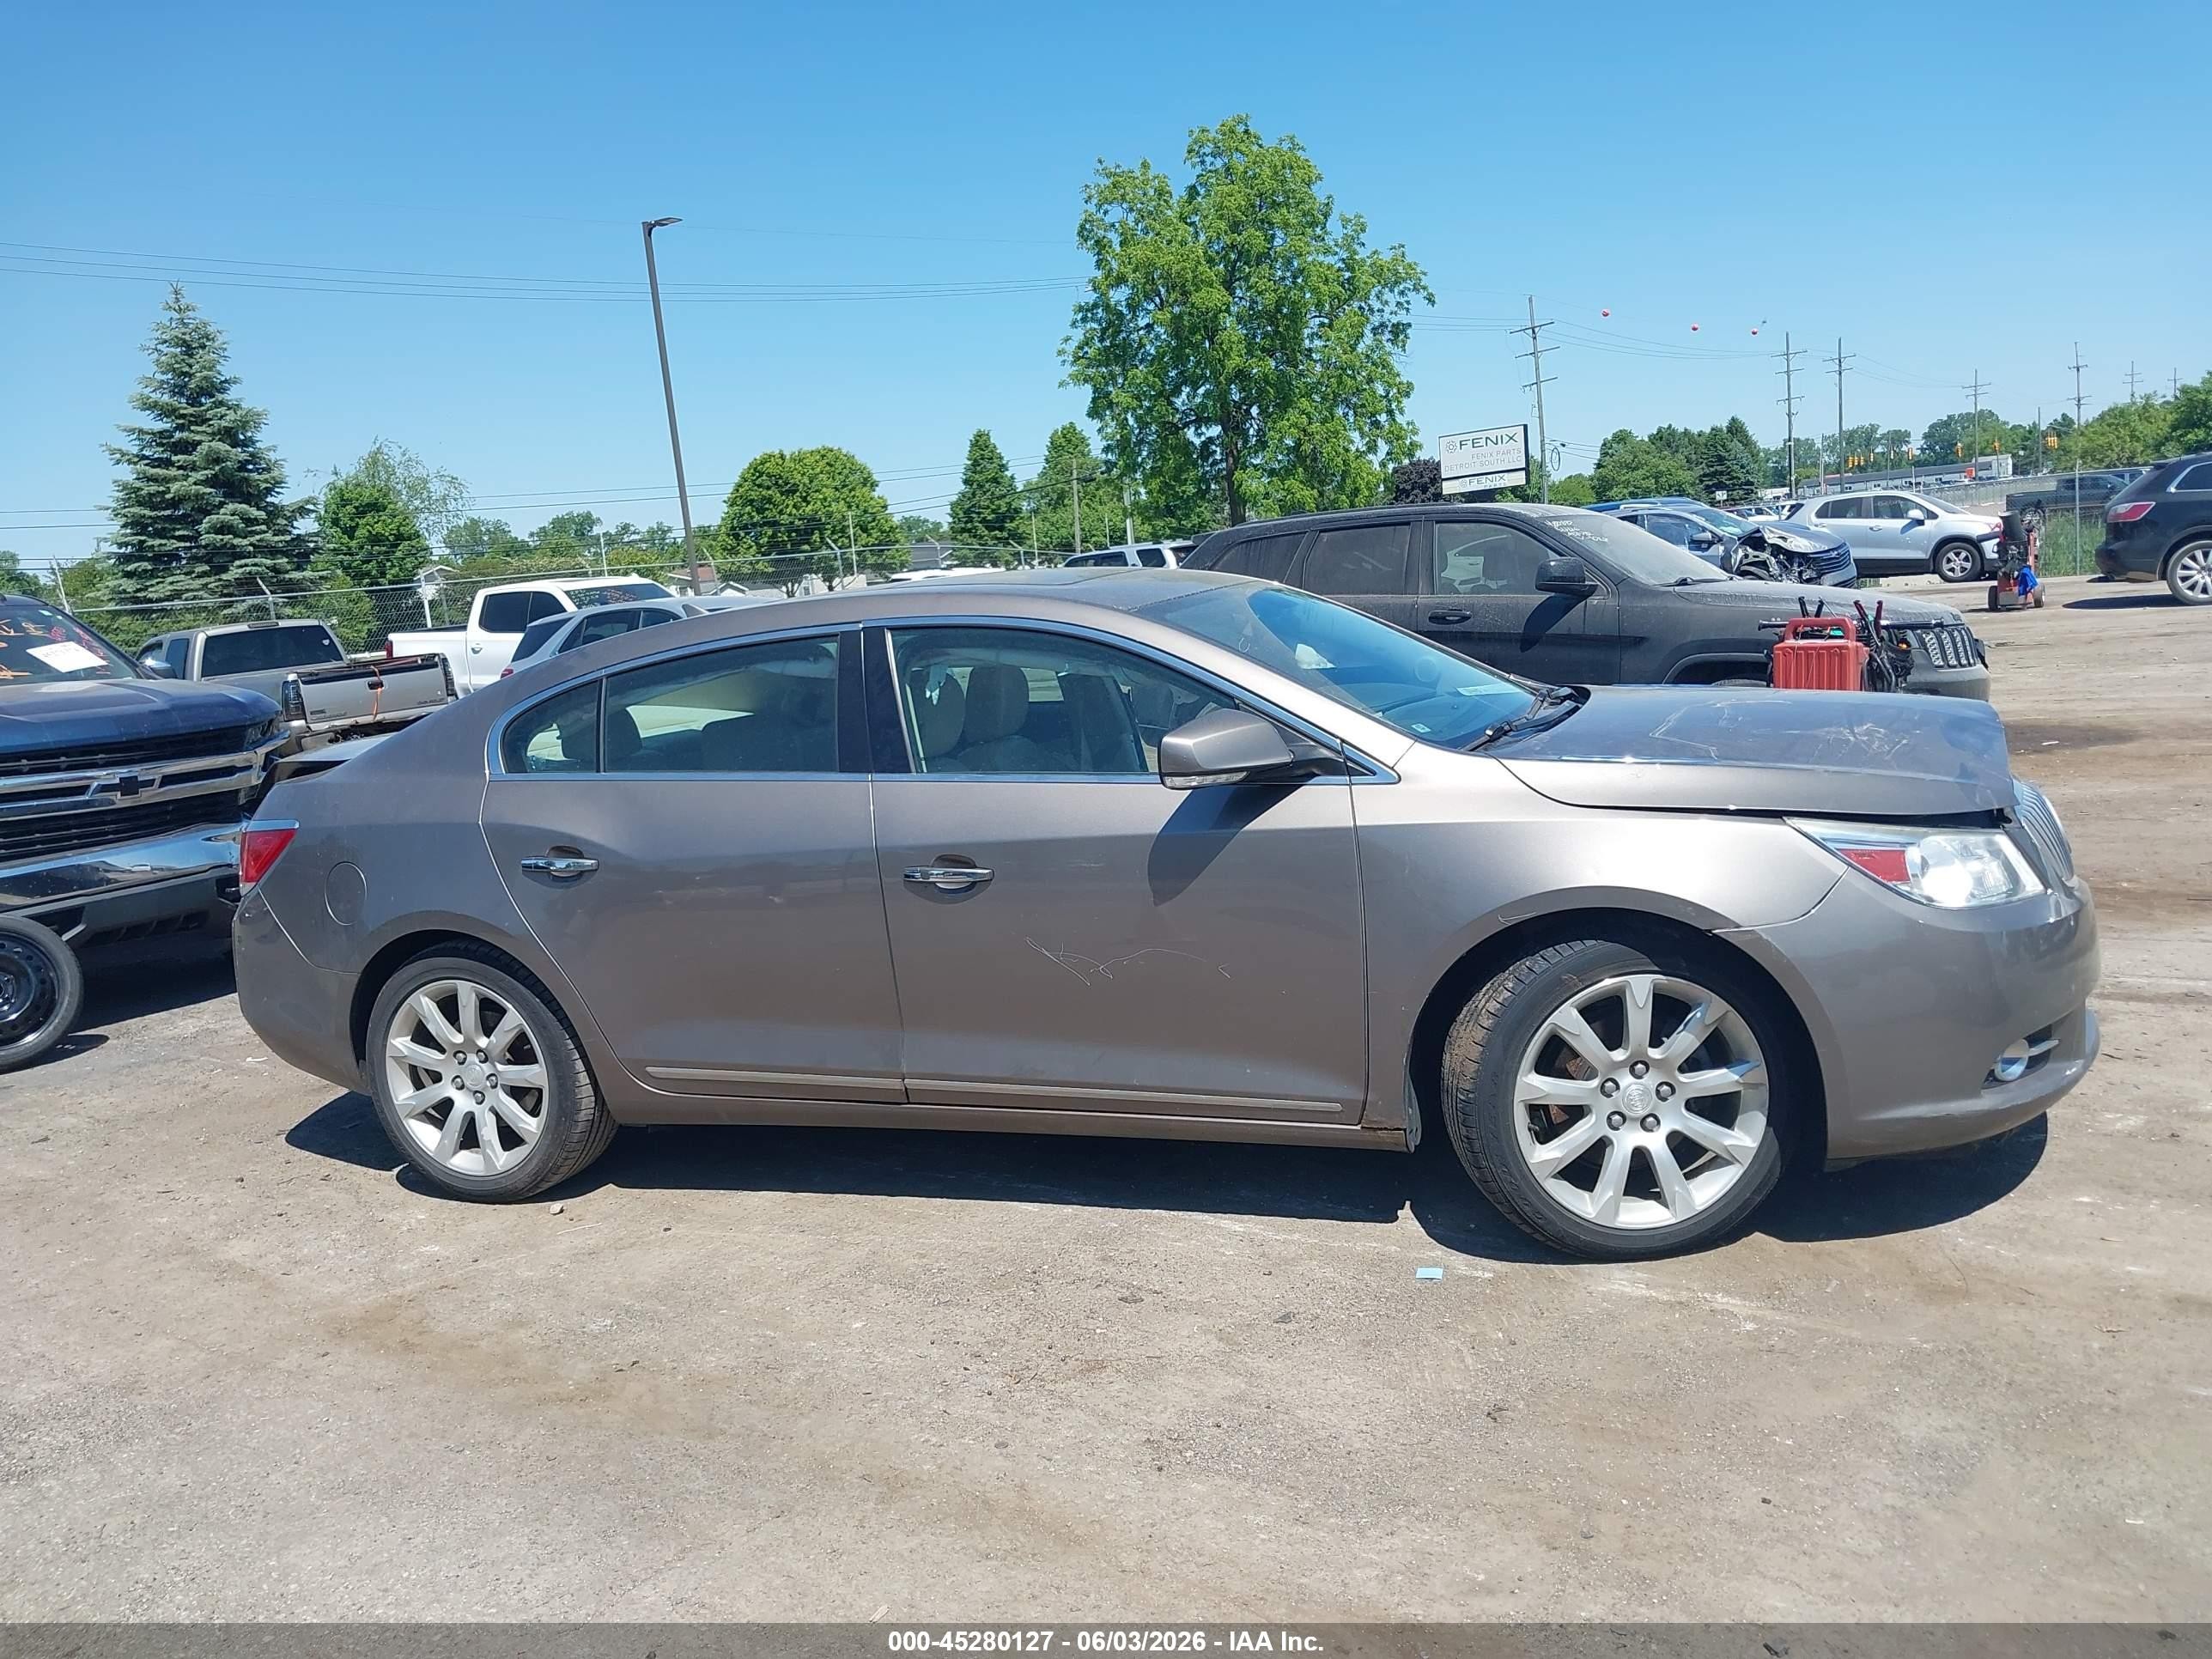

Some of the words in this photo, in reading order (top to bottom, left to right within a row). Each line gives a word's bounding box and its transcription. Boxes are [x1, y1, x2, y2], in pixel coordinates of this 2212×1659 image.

[1459, 432, 1518, 451] FENIX
[1471, 452, 1494, 460] FENIX
[1496, 447, 1522, 457] PARTS
[1444, 461, 1477, 472] DETROIT
[1479, 457, 1505, 467] SOUTH
[1507, 455, 1522, 465] LLC
[1468, 474, 1506, 486] FENIX
